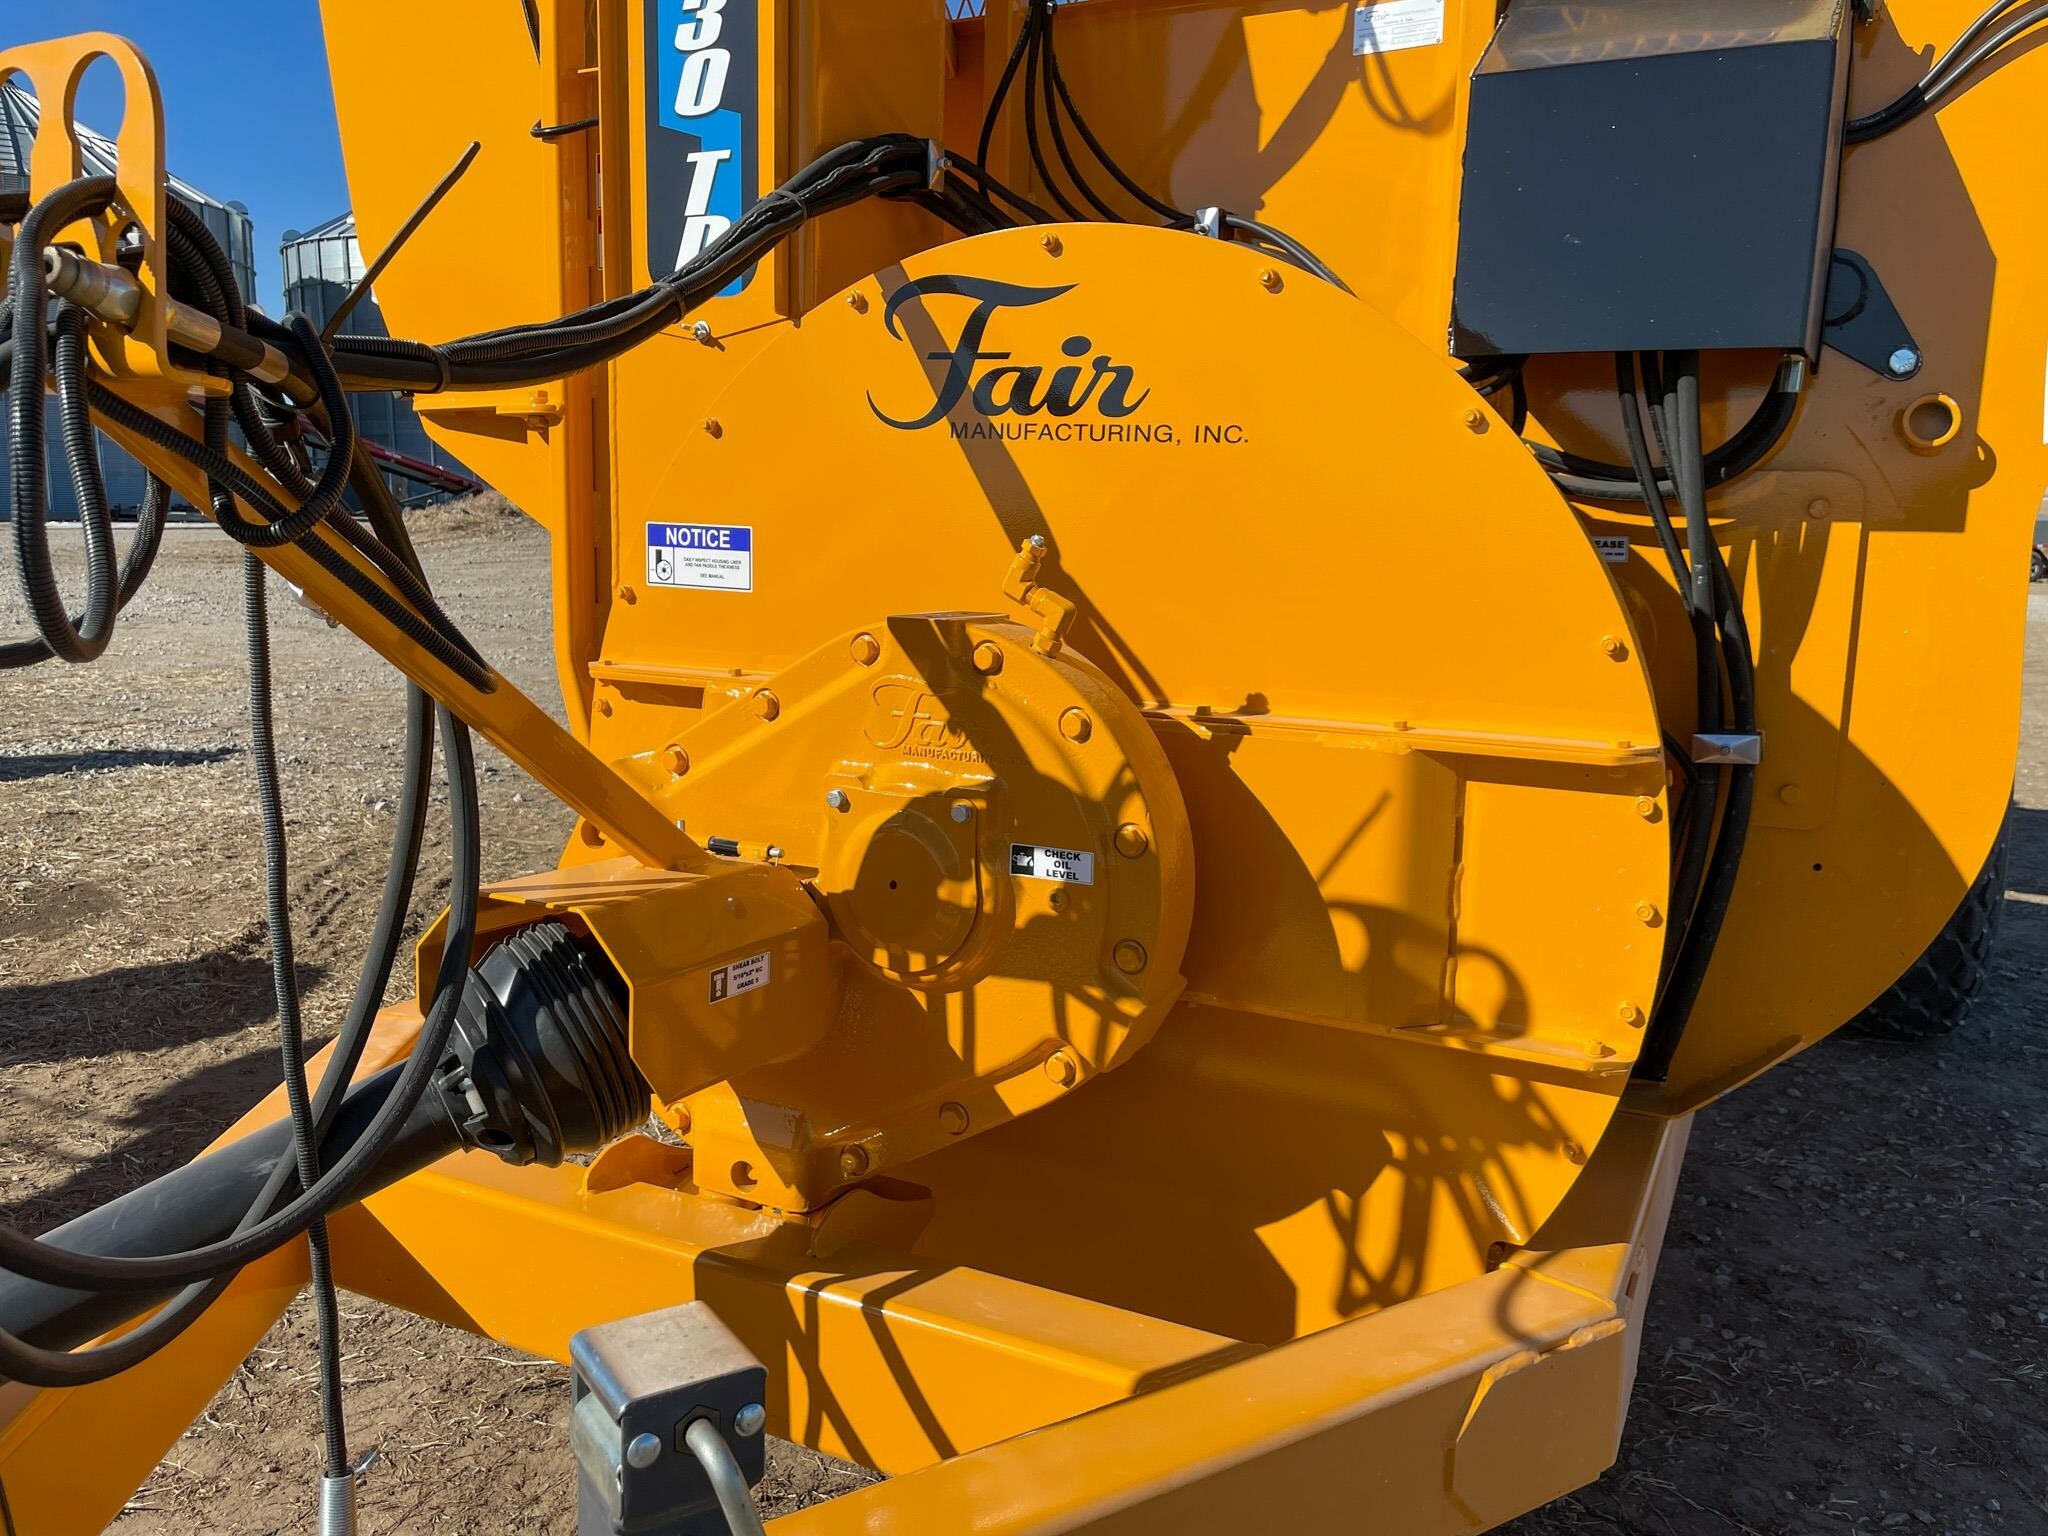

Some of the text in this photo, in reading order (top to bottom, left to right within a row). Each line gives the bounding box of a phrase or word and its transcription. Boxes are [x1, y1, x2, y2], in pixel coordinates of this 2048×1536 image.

[866, 274, 1151, 430] Fair
[950, 421, 1249, 446] MANUFACTURING, INC.
[665, 527, 731, 548] NOTICE
[1044, 849, 1081, 861] CHECK
[1053, 860, 1072, 870] OIL
[1045, 868, 1080, 881] LEVEL
[732, 955, 764, 971] SHEAR BOLT
[736, 979, 754, 990] GRADE
